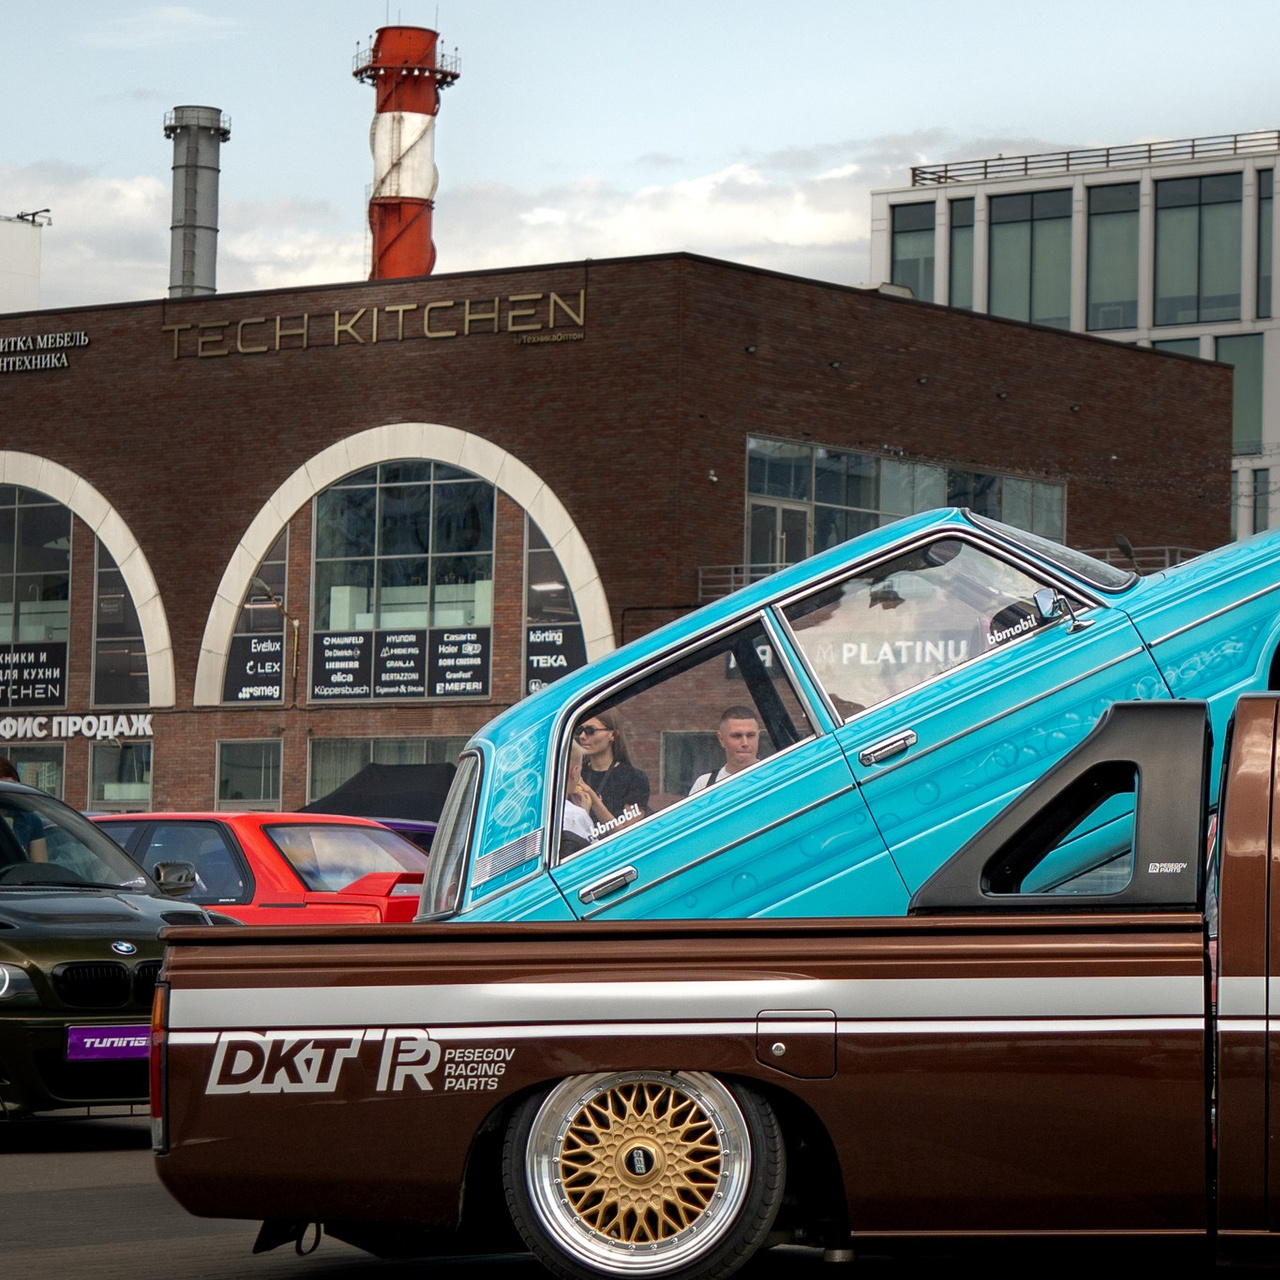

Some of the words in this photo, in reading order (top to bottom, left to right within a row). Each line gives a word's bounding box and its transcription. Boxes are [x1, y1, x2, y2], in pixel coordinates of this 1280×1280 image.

[161, 313, 309, 359] TECH
[334, 289, 586, 347] KITCHEN
[36, 331, 89, 349] МЕБЕЛЬ
[986, 613, 1038, 645] bbmobil
[529, 629, 563, 645] körting
[40, 651, 47, 663] И
[529, 655, 567, 668] TEKA
[23, 667, 60, 680] КУХНИ
[253, 685, 280, 698] smeg
[445, 681, 482, 691] MEFERI
[0, 716, 48, 739] ФИС
[52, 714, 154, 740] ПРОДАЖ
[589, 802, 642, 838] bbmobil
[444, 1047, 516, 1062] PESEGOV
[207, 1033, 362, 1093] DKT
[444, 1062, 506, 1077] RACING
[444, 1077, 499, 1091] PARTS
